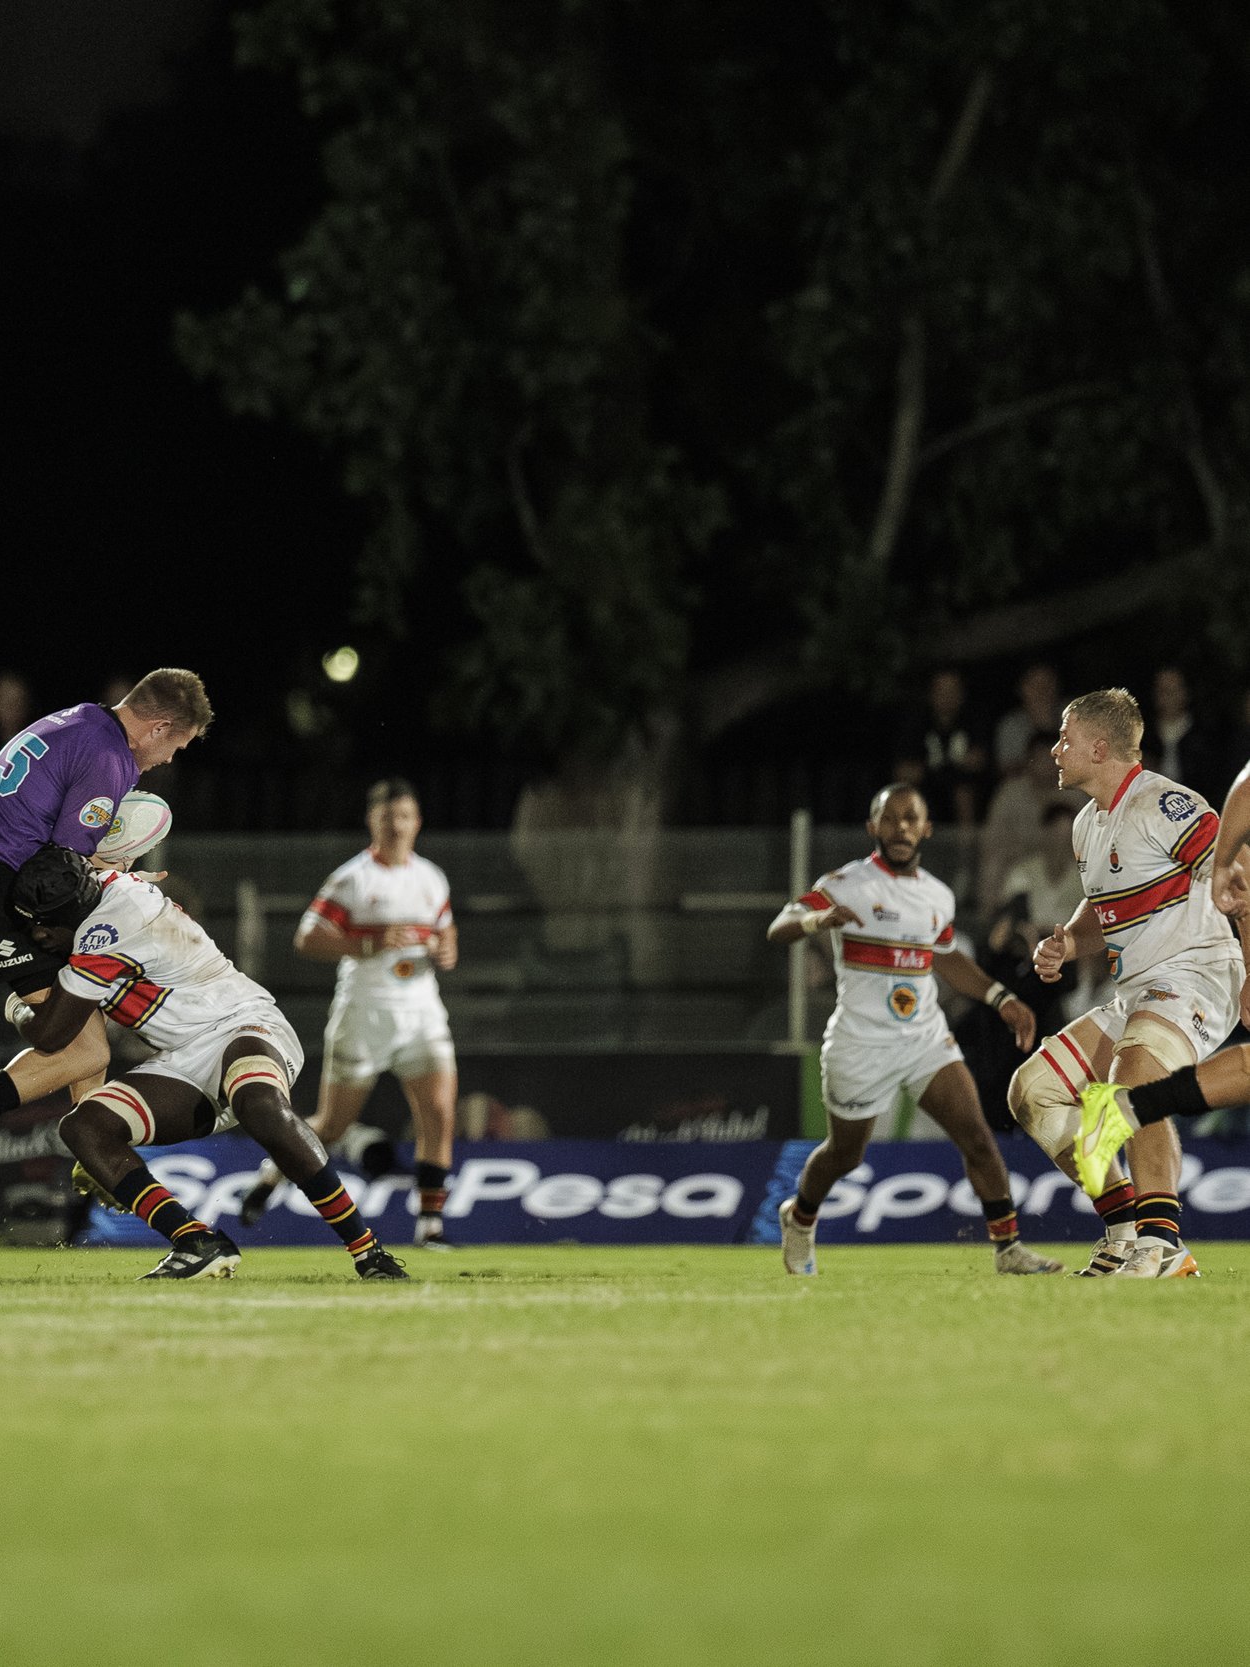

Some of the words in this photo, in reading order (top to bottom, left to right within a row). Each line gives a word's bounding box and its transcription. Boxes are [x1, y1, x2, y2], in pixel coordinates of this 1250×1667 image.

[1166, 796, 1185, 809] TW
[90, 934, 110, 945] TW
[893, 949, 925, 968] Tuks
